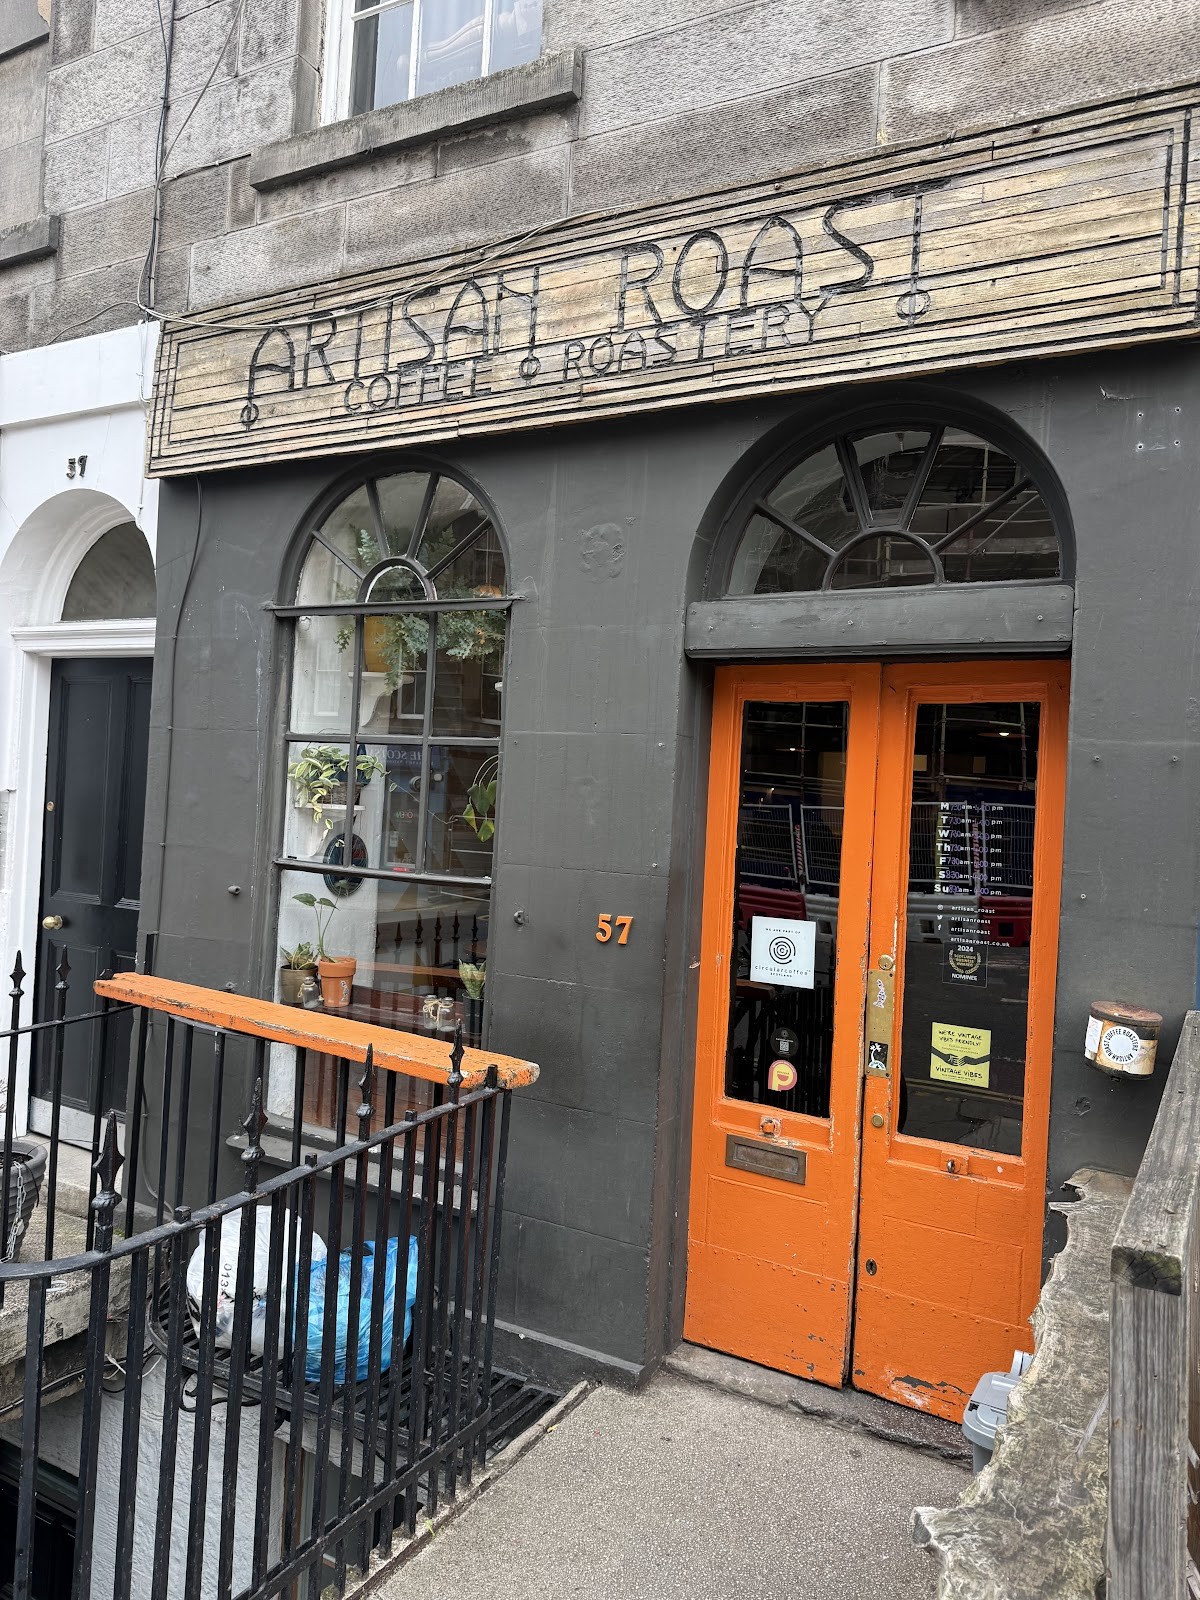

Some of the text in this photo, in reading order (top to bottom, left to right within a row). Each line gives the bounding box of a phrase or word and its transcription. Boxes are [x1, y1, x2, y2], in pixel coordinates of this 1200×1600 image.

[242, 181, 952, 429] ARTISAN ROAST
[344, 291, 839, 415] COFFEE ROASTERY
[940, 802, 949, 811] M
[940, 815, 949, 824] T
[938, 829, 949, 838] W
[935, 843, 950, 852] Th
[939, 857, 947, 865] F
[938, 870, 946, 879] S
[934, 883, 949, 893] Su
[950, 916, 991, 925] artisanroast
[595, 913, 634, 945] 57
[950, 927, 991, 936] artisanroast
[950, 937, 1010, 948] artisanroast.co.uk
[957, 944, 974, 953] 2024
[951, 972, 978, 981] NOMINEE
[935, 1065, 962, 1076] VINTAGE
[963, 1069, 983, 1079] VIBES
